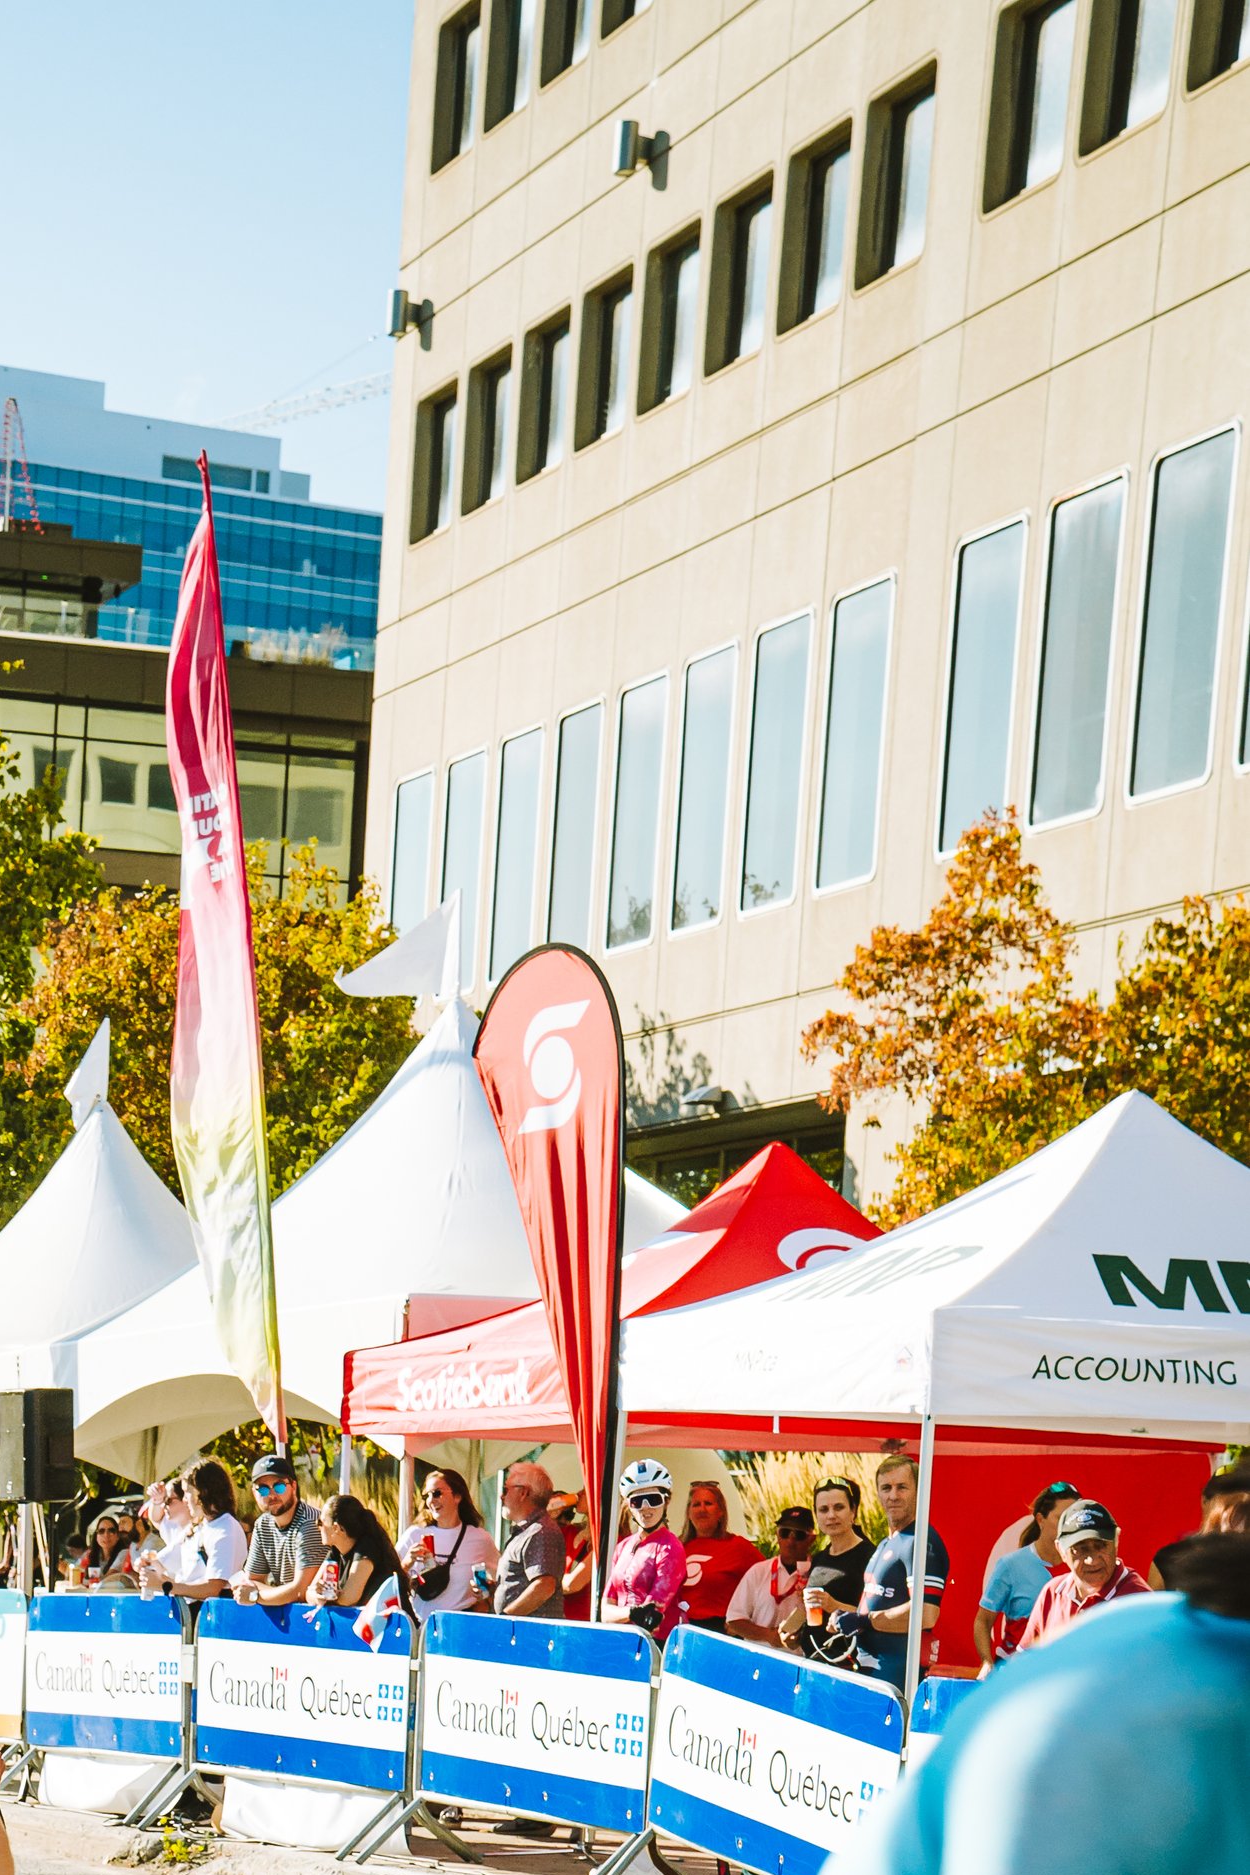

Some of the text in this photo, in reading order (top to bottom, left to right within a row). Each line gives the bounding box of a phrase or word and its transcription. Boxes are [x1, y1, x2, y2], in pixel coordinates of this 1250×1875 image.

[765, 1245, 984, 1302] MNP
[395, 1358, 531, 1412] Scotiabank
[1032, 1354, 1237, 1386] ACCOUNTING
[34, 1651, 155, 1698] Canada Québec
[209, 1660, 372, 1720] Canada Québec
[437, 1680, 610, 1752] Canada Québec
[668, 1704, 854, 1823] Canada Québec
